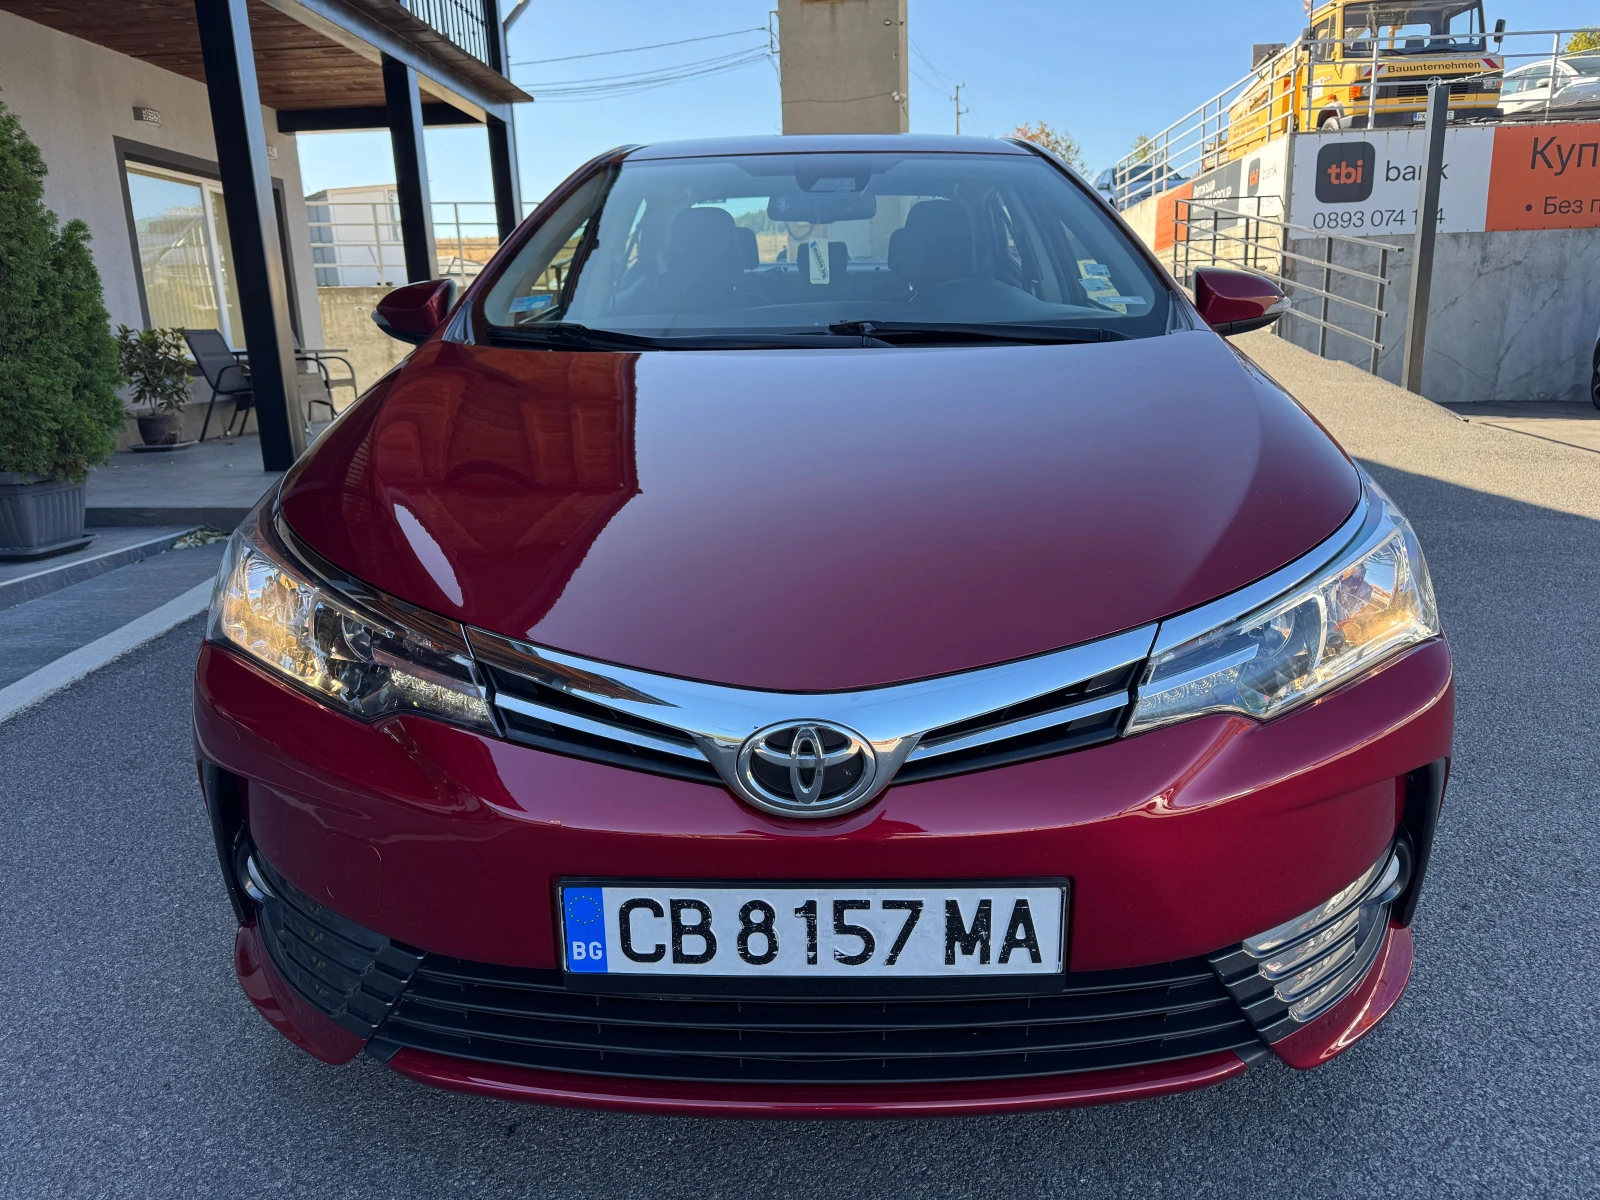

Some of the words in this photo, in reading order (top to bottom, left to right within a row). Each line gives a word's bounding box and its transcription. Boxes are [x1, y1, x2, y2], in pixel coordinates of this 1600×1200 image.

[1387, 61, 1481, 73] Bauunternehmen
[1530, 136, 1599, 176] Куп
[1327, 159, 1363, 185] tbi
[1543, 196, 1583, 215] Без
[1313, 210, 1365, 230] 0893
[1370, 209, 1406, 227] 074
[1411, 207, 1445, 226] 14
[618, 897, 718, 966] CB
[736, 897, 925, 966] 8157
[944, 898, 1042, 965] MA
[572, 940, 603, 961] BG
